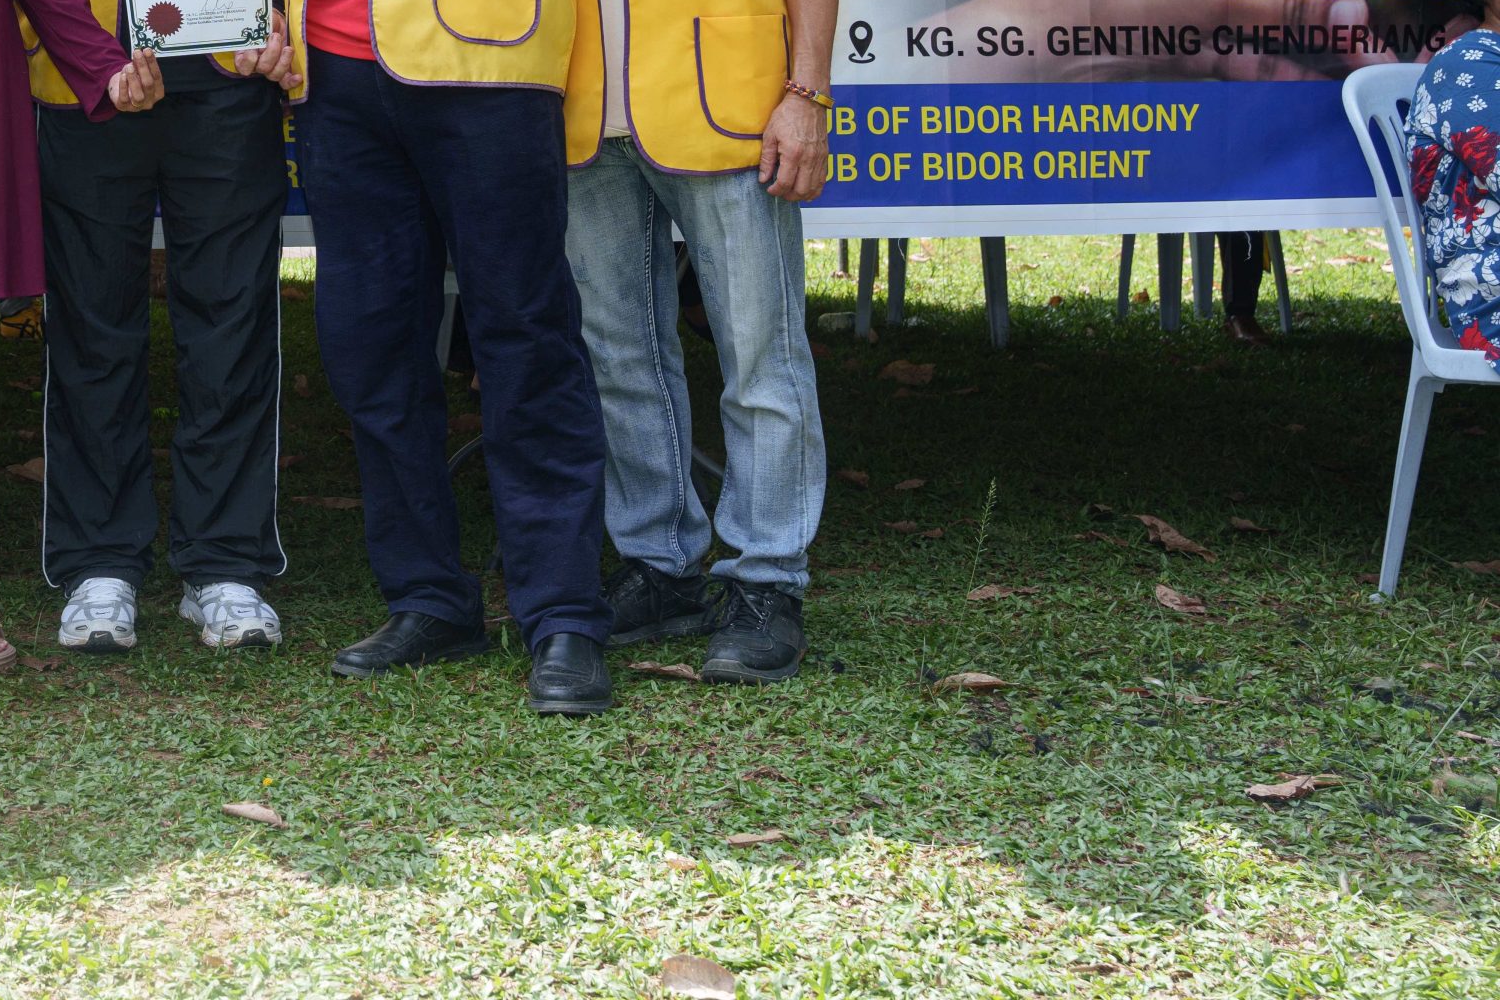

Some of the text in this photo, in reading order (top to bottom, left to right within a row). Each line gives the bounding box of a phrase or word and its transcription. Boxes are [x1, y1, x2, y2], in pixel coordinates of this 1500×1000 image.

[907, 24, 1446, 58] KG. SG. GENTING CHENDERIANG
[867, 106, 910, 135] OF
[921, 104, 1023, 135] BIDOR
[1032, 103, 1200, 134] HARMONY
[868, 152, 912, 182] OF
[922, 151, 1025, 181] BIDOR
[1033, 150, 1151, 180] ORIENT
